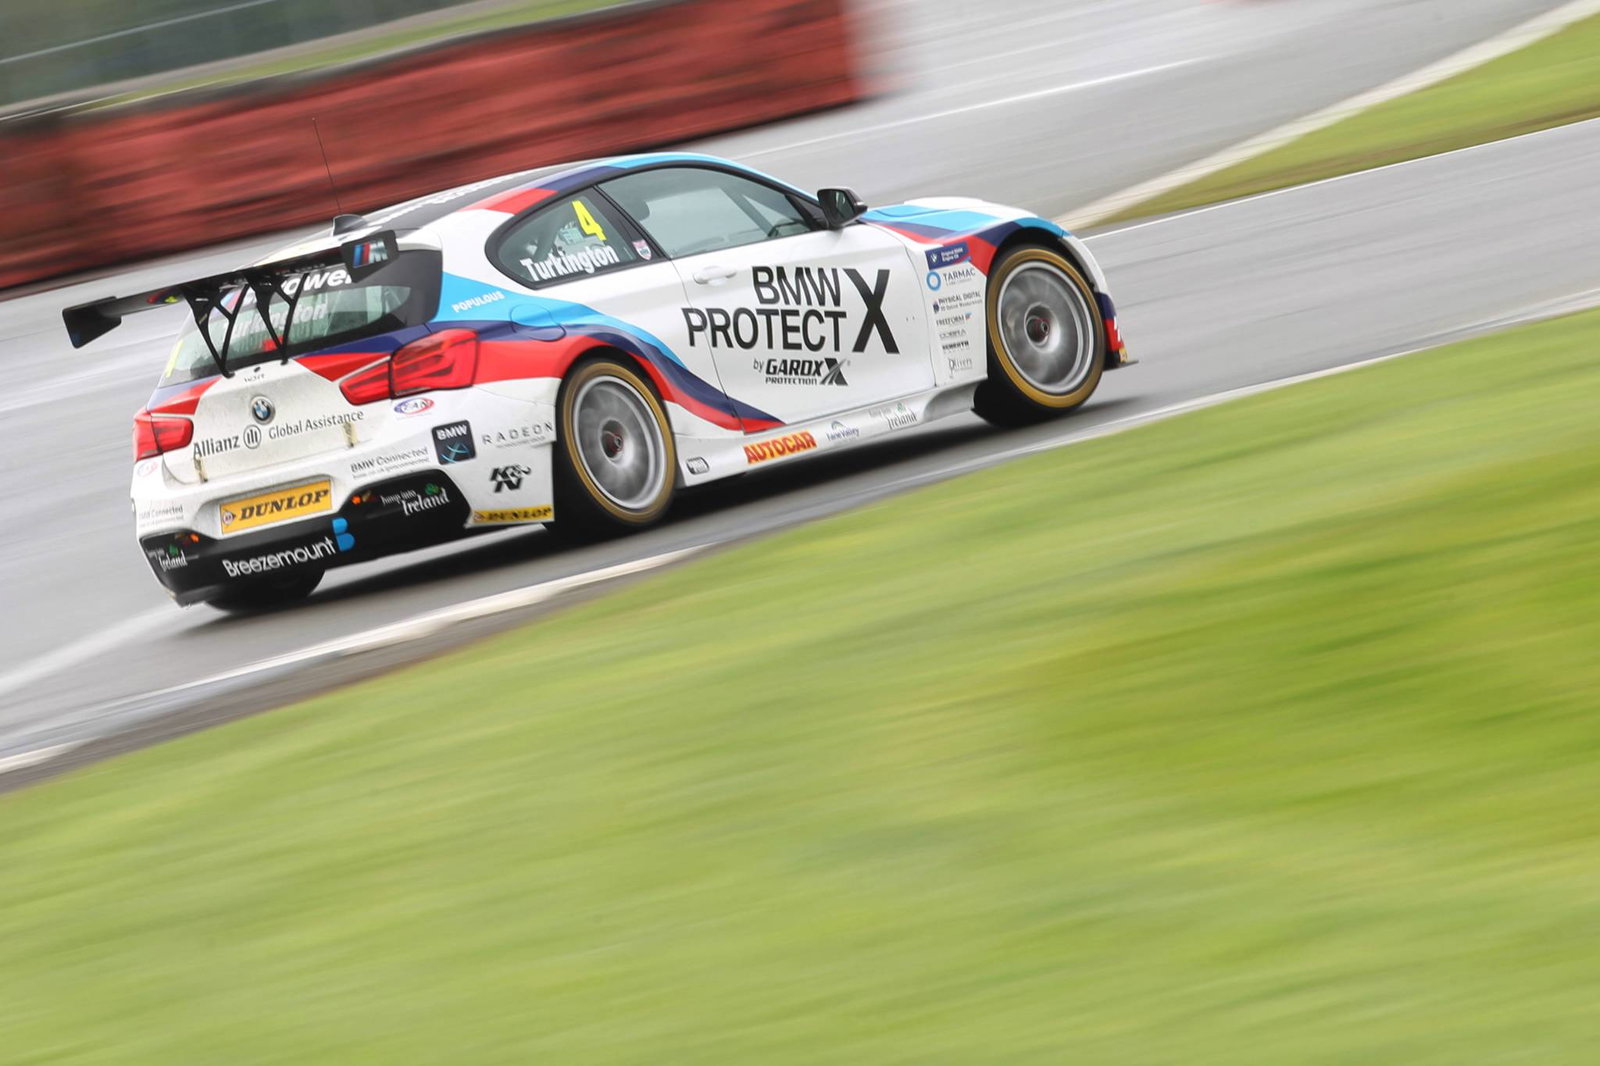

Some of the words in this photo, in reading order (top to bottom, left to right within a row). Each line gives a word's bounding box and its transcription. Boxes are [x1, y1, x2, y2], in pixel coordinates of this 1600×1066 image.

[572, 199, 608, 240] 4
[520, 243, 620, 281] Turkington
[943, 268, 976, 281] TARMAC
[452, 290, 505, 313] POPULOUS
[752, 266, 841, 307] BMW
[843, 268, 900, 354] X
[681, 307, 847, 352] PROTECT
[752, 358, 765, 373] by
[192, 433, 240, 459] Allianz
[268, 420, 303, 441] Global
[304, 410, 365, 431] Assistance
[436, 424, 469, 441] BMW
[482, 421, 554, 445] RADEON
[886, 407, 918, 431] Ireland
[743, 428, 817, 464] AUTOCAR
[350, 457, 375, 473] BMW
[240, 488, 329, 521] DUNLOP
[401, 487, 450, 516] Ireland
[158, 549, 188, 573] Ireland
[222, 536, 337, 578] Breezemount
